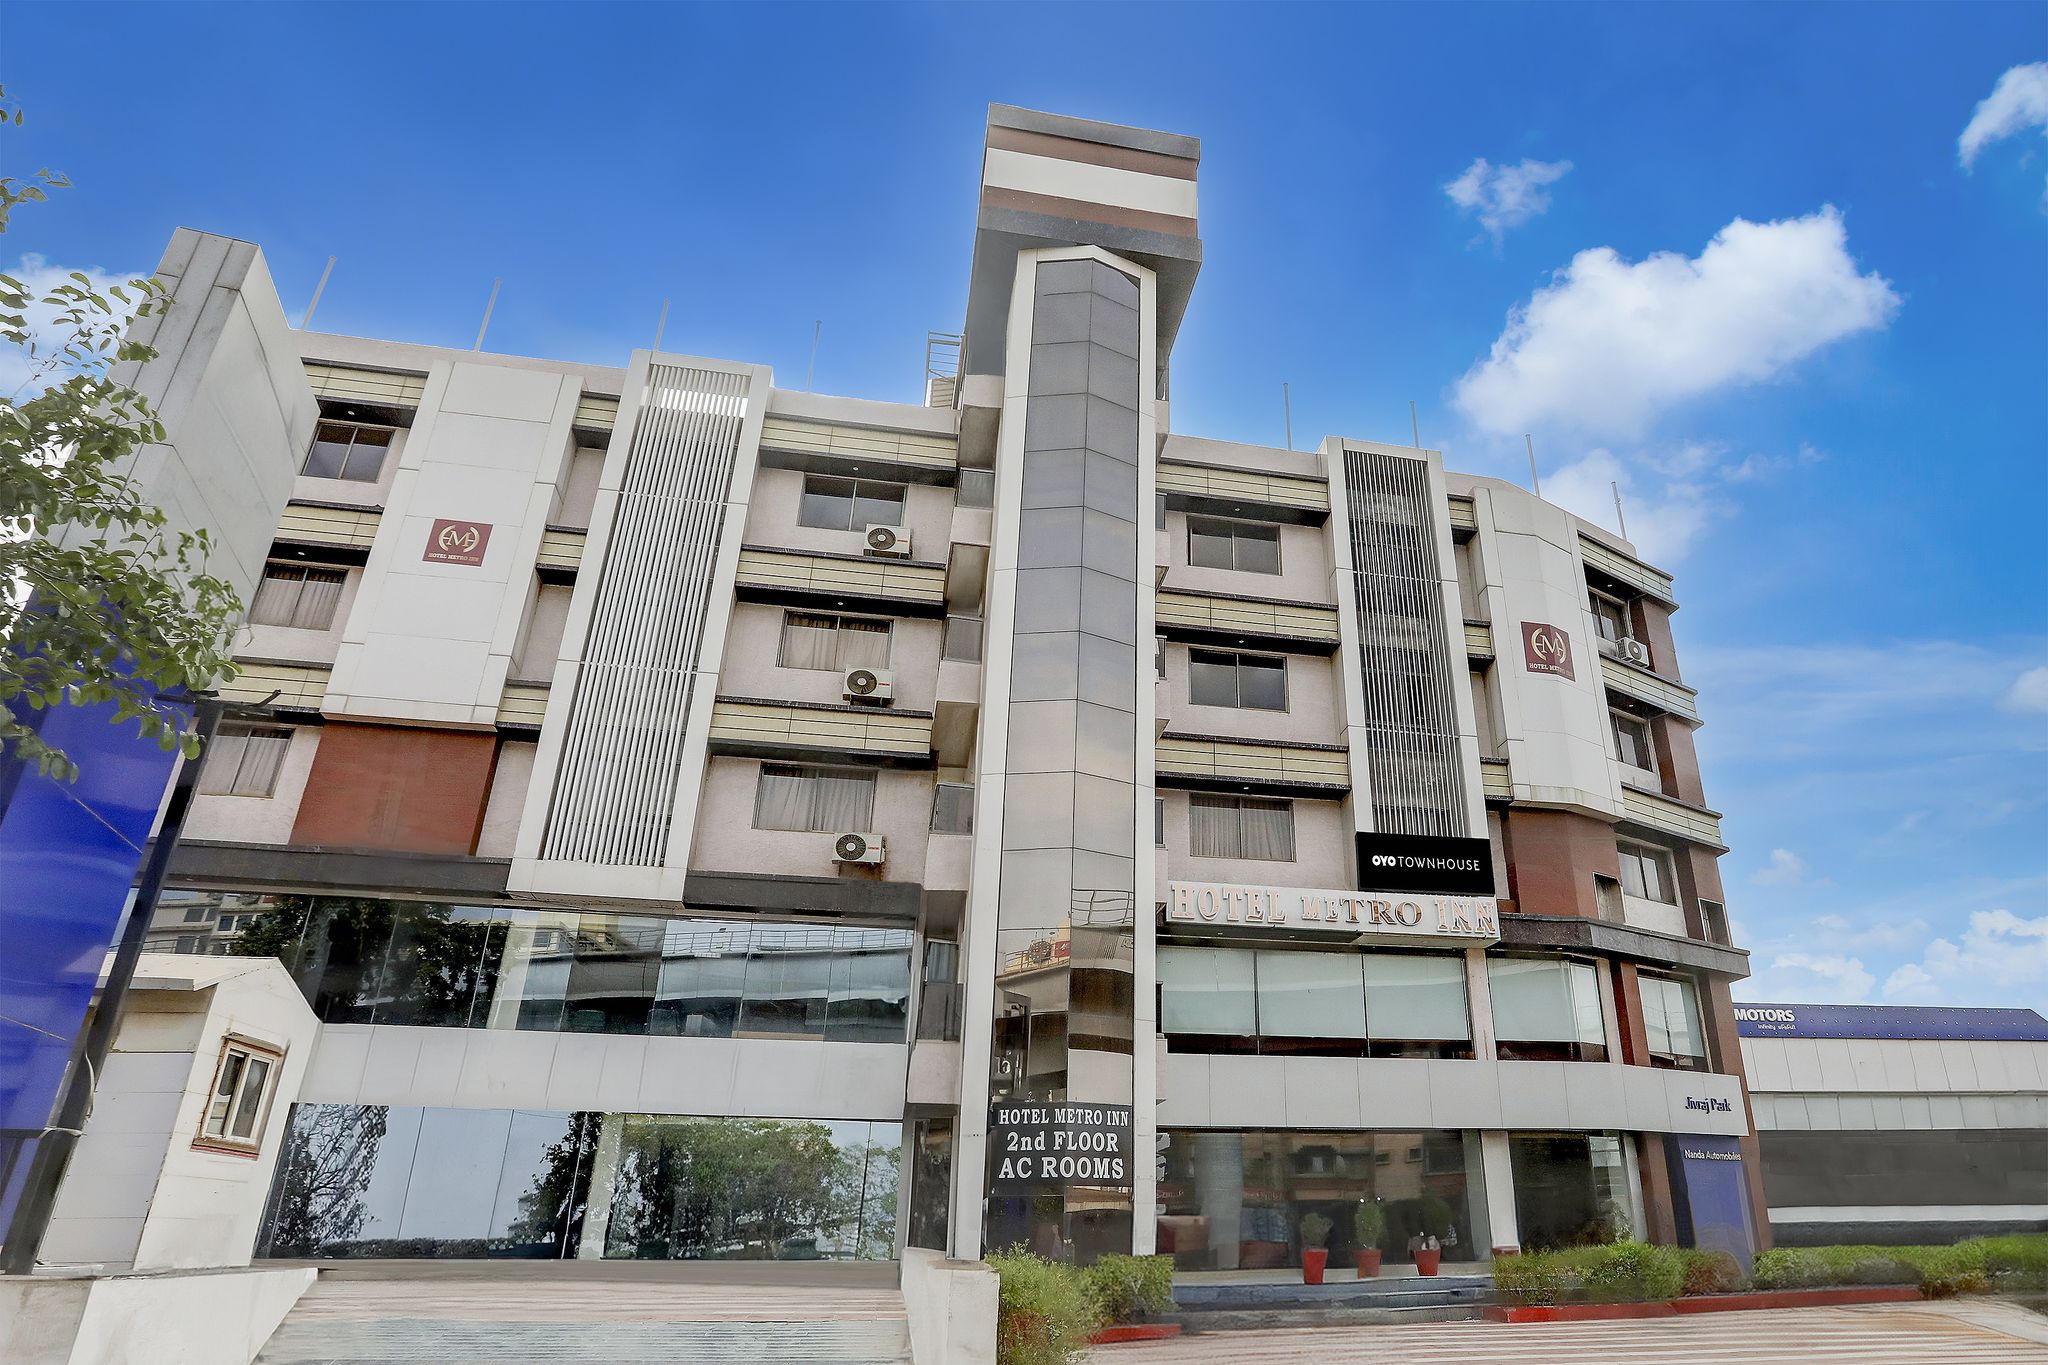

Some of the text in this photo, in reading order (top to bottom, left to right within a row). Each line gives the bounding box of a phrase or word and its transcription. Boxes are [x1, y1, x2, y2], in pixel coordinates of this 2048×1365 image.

[1528, 662, 1549, 670] HOTEL
[1372, 854, 1480, 871] OYO TOWNHOUSE
[1171, 882, 1496, 934] HOTEL METRO INN
[1733, 1008, 1795, 1021] MOTORS
[999, 1108, 1129, 1127] HOTEL METRO INN
[1007, 1130, 1119, 1153] 2nd FLOOR
[1684, 1149, 1705, 1160] Nanda
[998, 1156, 1124, 1180] AC ROOMS
